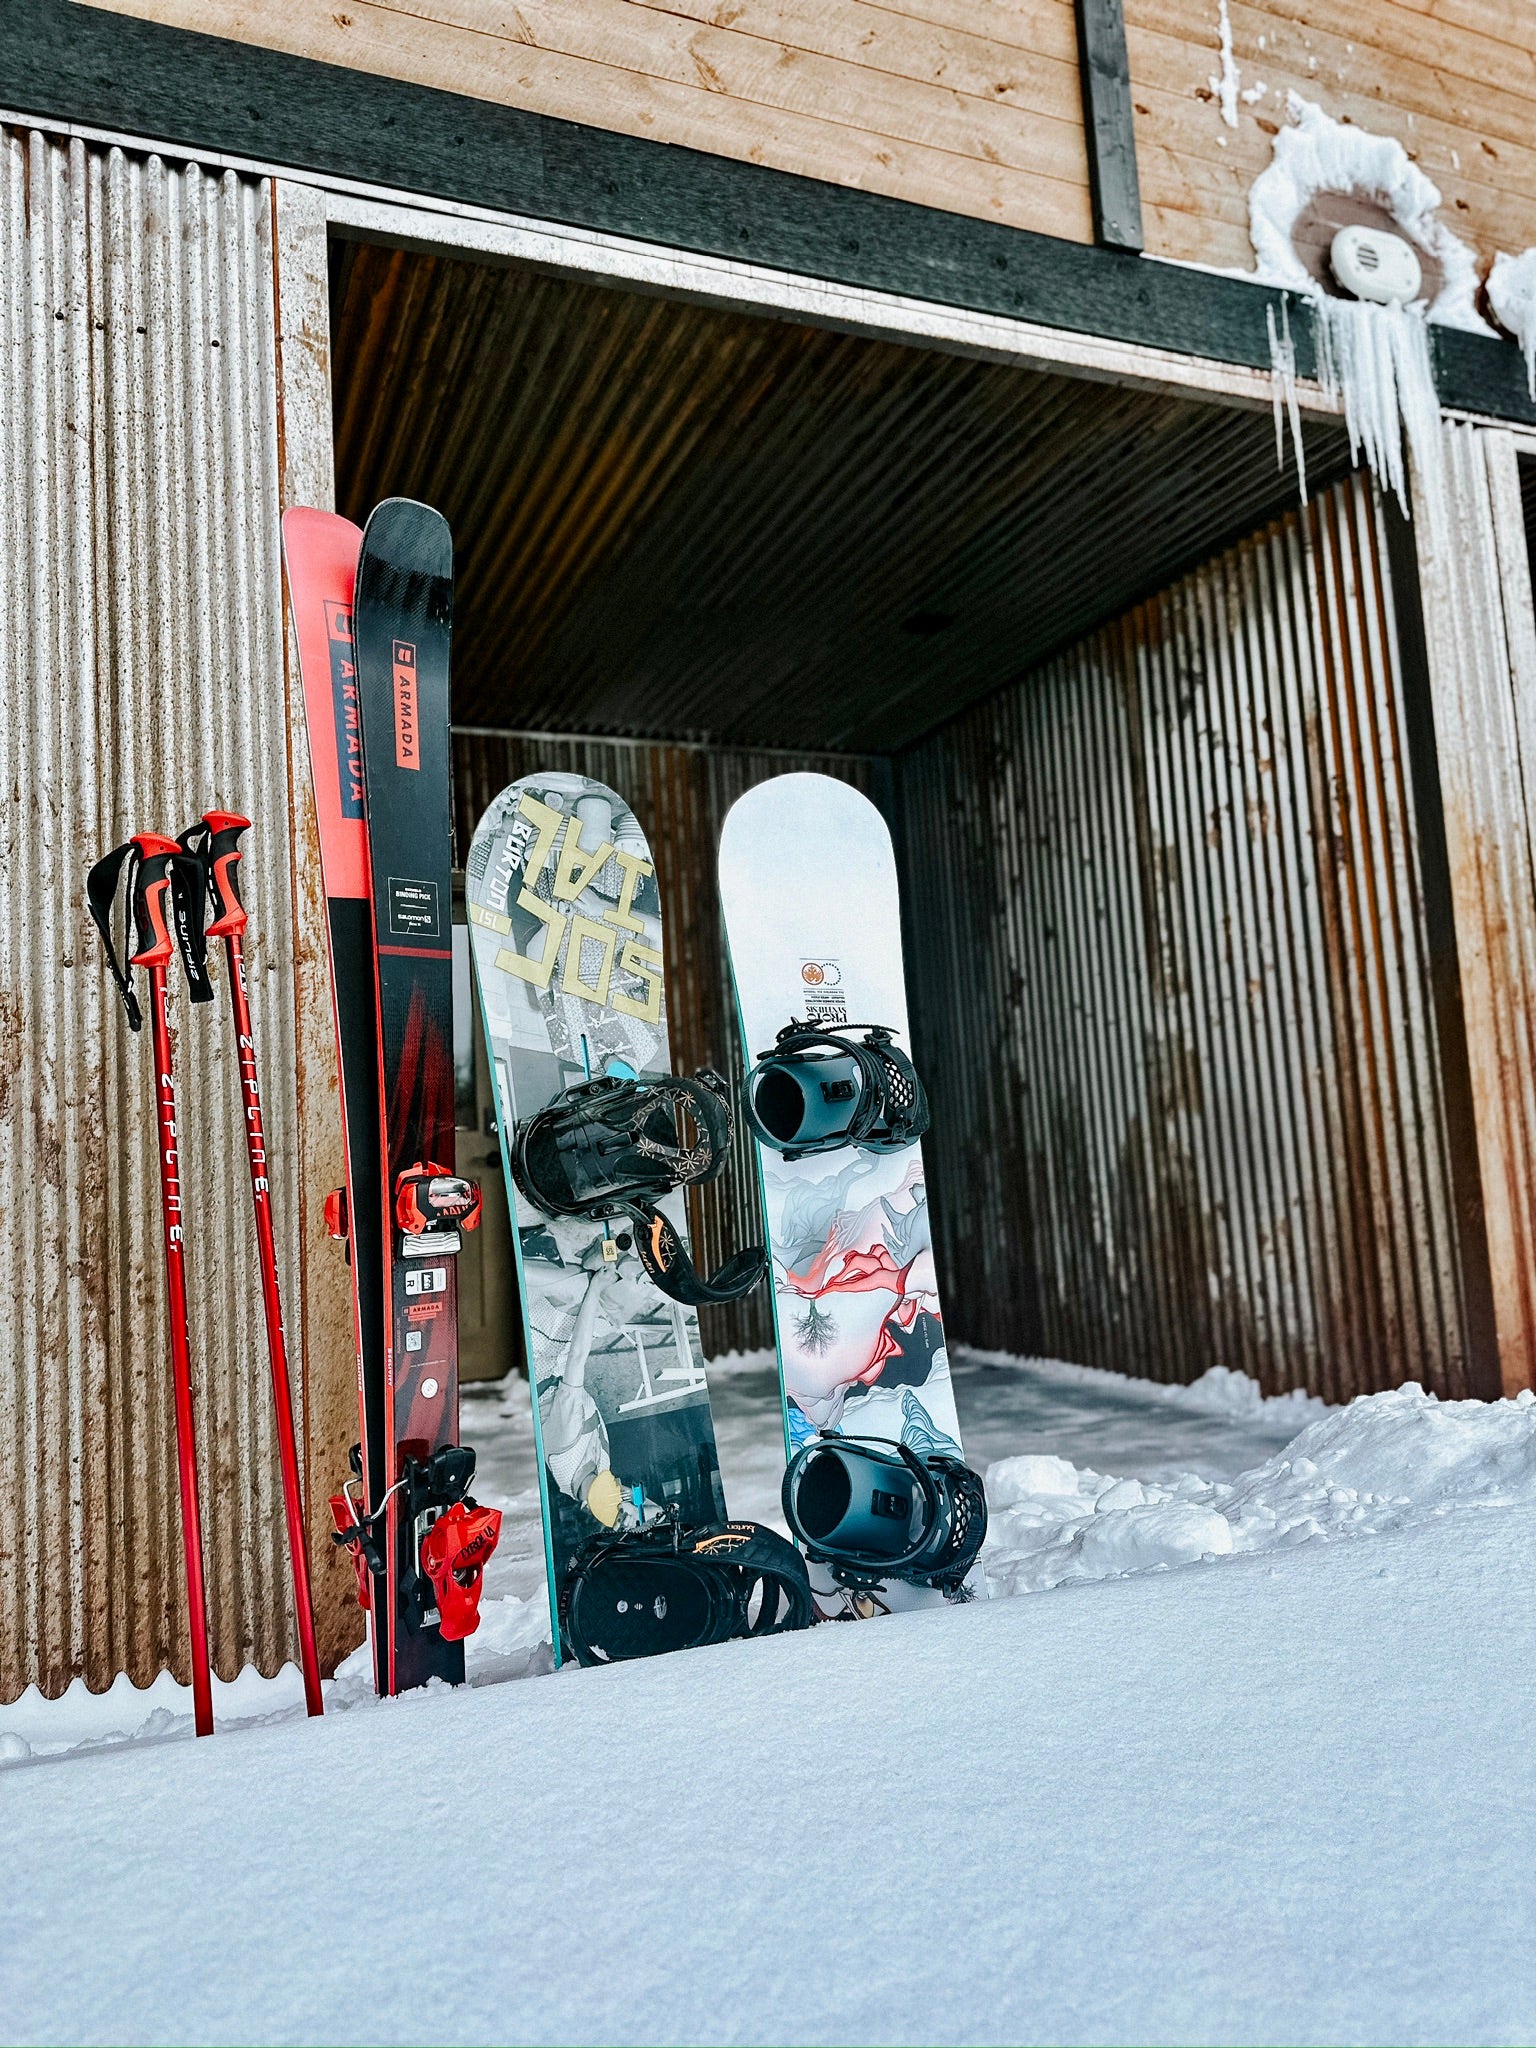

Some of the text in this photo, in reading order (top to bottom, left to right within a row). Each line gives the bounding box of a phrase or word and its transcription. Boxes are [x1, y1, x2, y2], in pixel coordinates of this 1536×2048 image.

[399, 675, 413, 757] ARMADA
[486, 819, 533, 911] BURTON
[395, 891, 418, 899] BINDING
[479, 909, 498, 929] 151
[239, 1034, 269, 1192] ZIPLINE
[161, 1073, 183, 1242] ZIPLINE
[412, 1304, 440, 1312] ARMADA
[726, 1524, 756, 1533] burton
